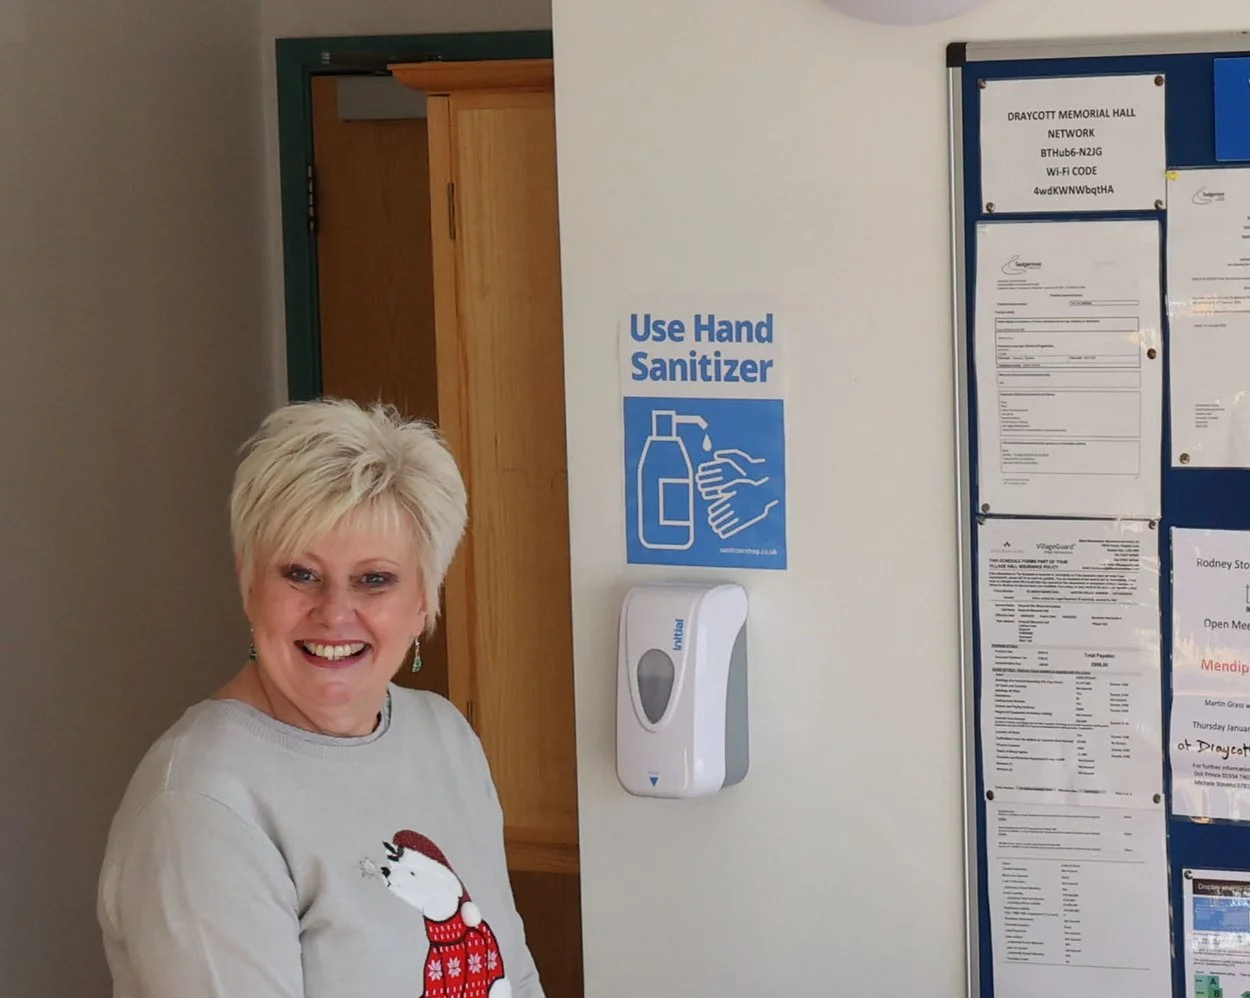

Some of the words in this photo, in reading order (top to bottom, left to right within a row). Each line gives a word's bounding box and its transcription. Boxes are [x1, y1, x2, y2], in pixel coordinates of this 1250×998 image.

[1008, 111, 1056, 121] DRAYCOTT
[1059, 110, 1110, 119] MEMORIAL
[1113, 108, 1135, 117] HALL
[1048, 129, 1094, 138] NETWORK
[1041, 148, 1102, 158] BTHub6-N2JG
[1046, 168, 1069, 176] Wi-Fi
[1073, 167, 1097, 175] CODE
[630, 314, 685, 342] Use
[694, 314, 773, 343] Hand
[631, 350, 773, 382] Sanitizer
[1196, 558, 1232, 570] Rodney
[1204, 618, 1228, 630] Open
[673, 618, 684, 650] Initial
[1201, 660, 1249, 674] Mendip
[1193, 721, 1224, 732] Thursday
[1178, 740, 1191, 750] at
